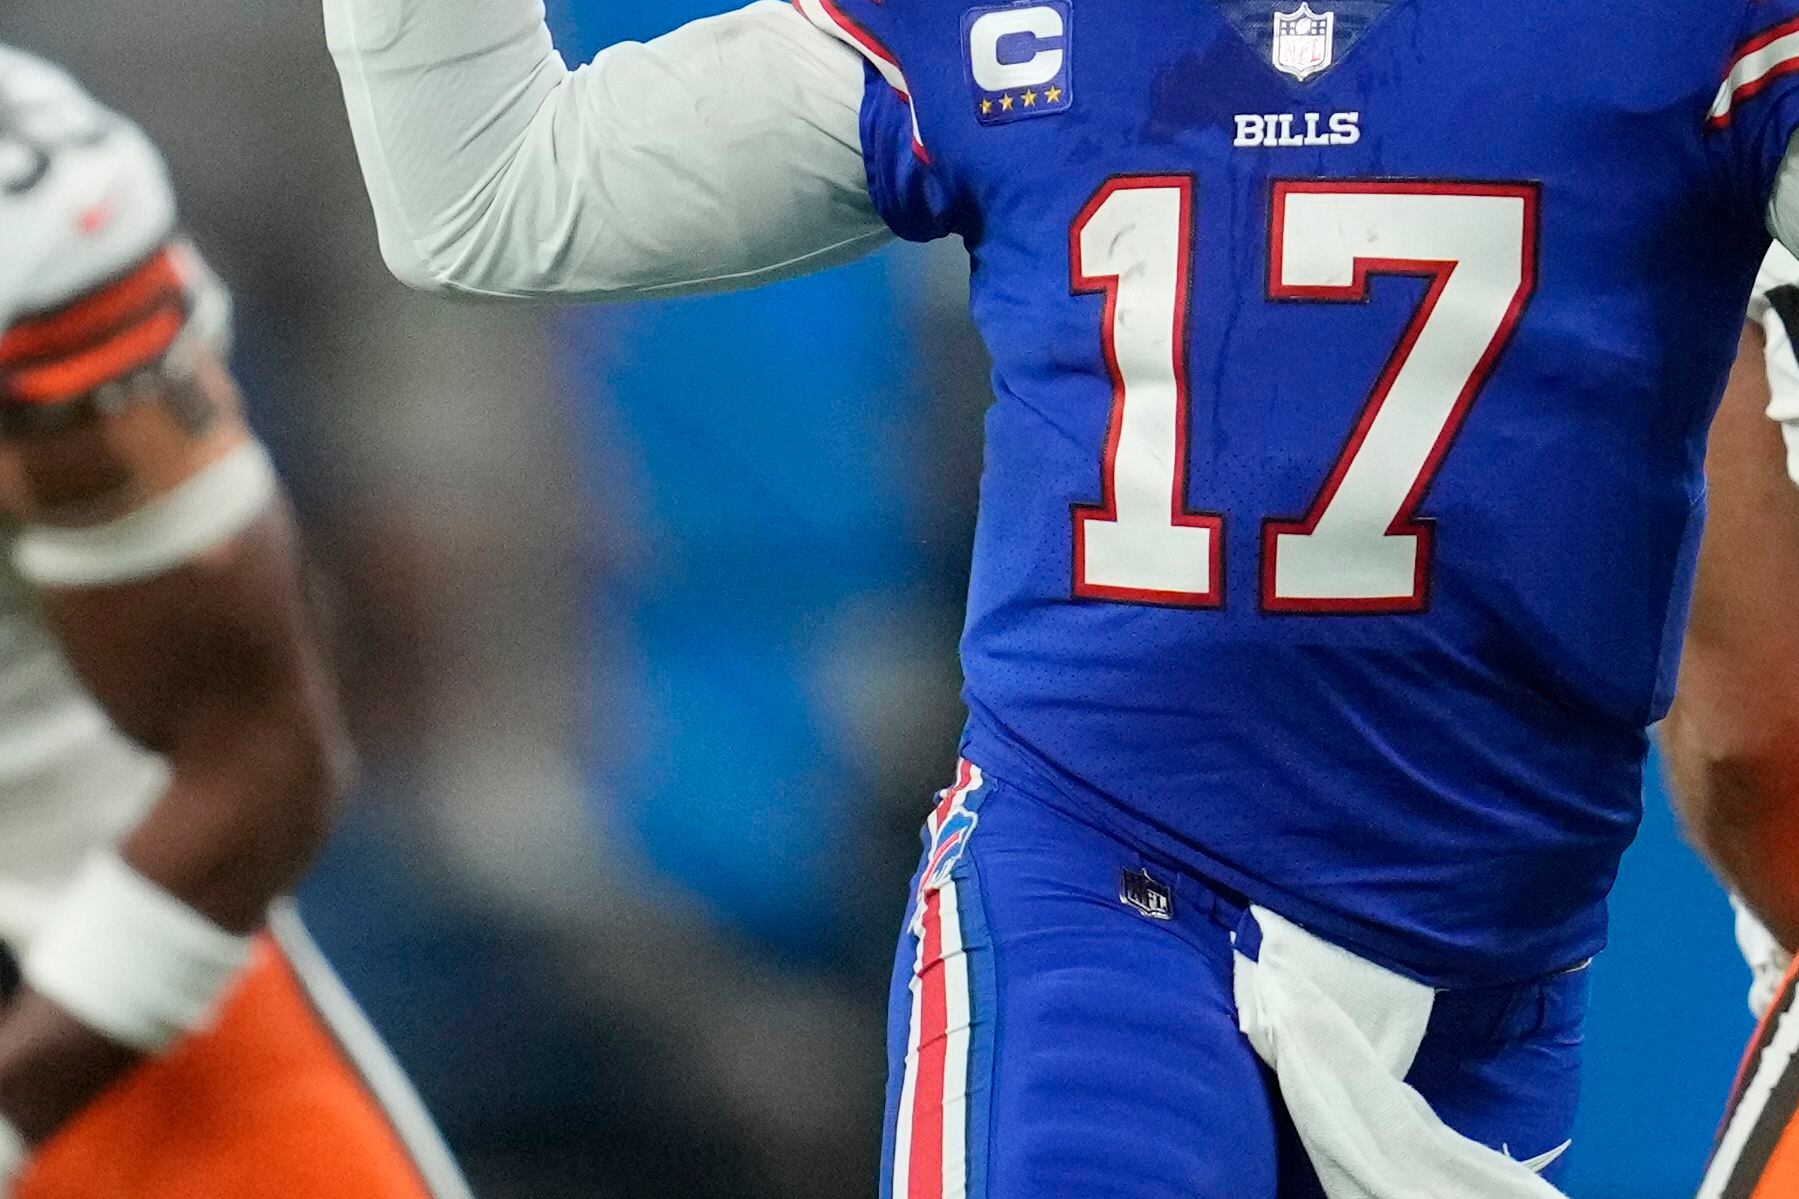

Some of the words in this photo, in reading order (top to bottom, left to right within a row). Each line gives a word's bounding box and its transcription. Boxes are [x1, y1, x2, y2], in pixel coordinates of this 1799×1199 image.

[969, 4, 1064, 92] C
[1233, 111, 1361, 147] BILLS
[1068, 171, 1542, 614] 17
